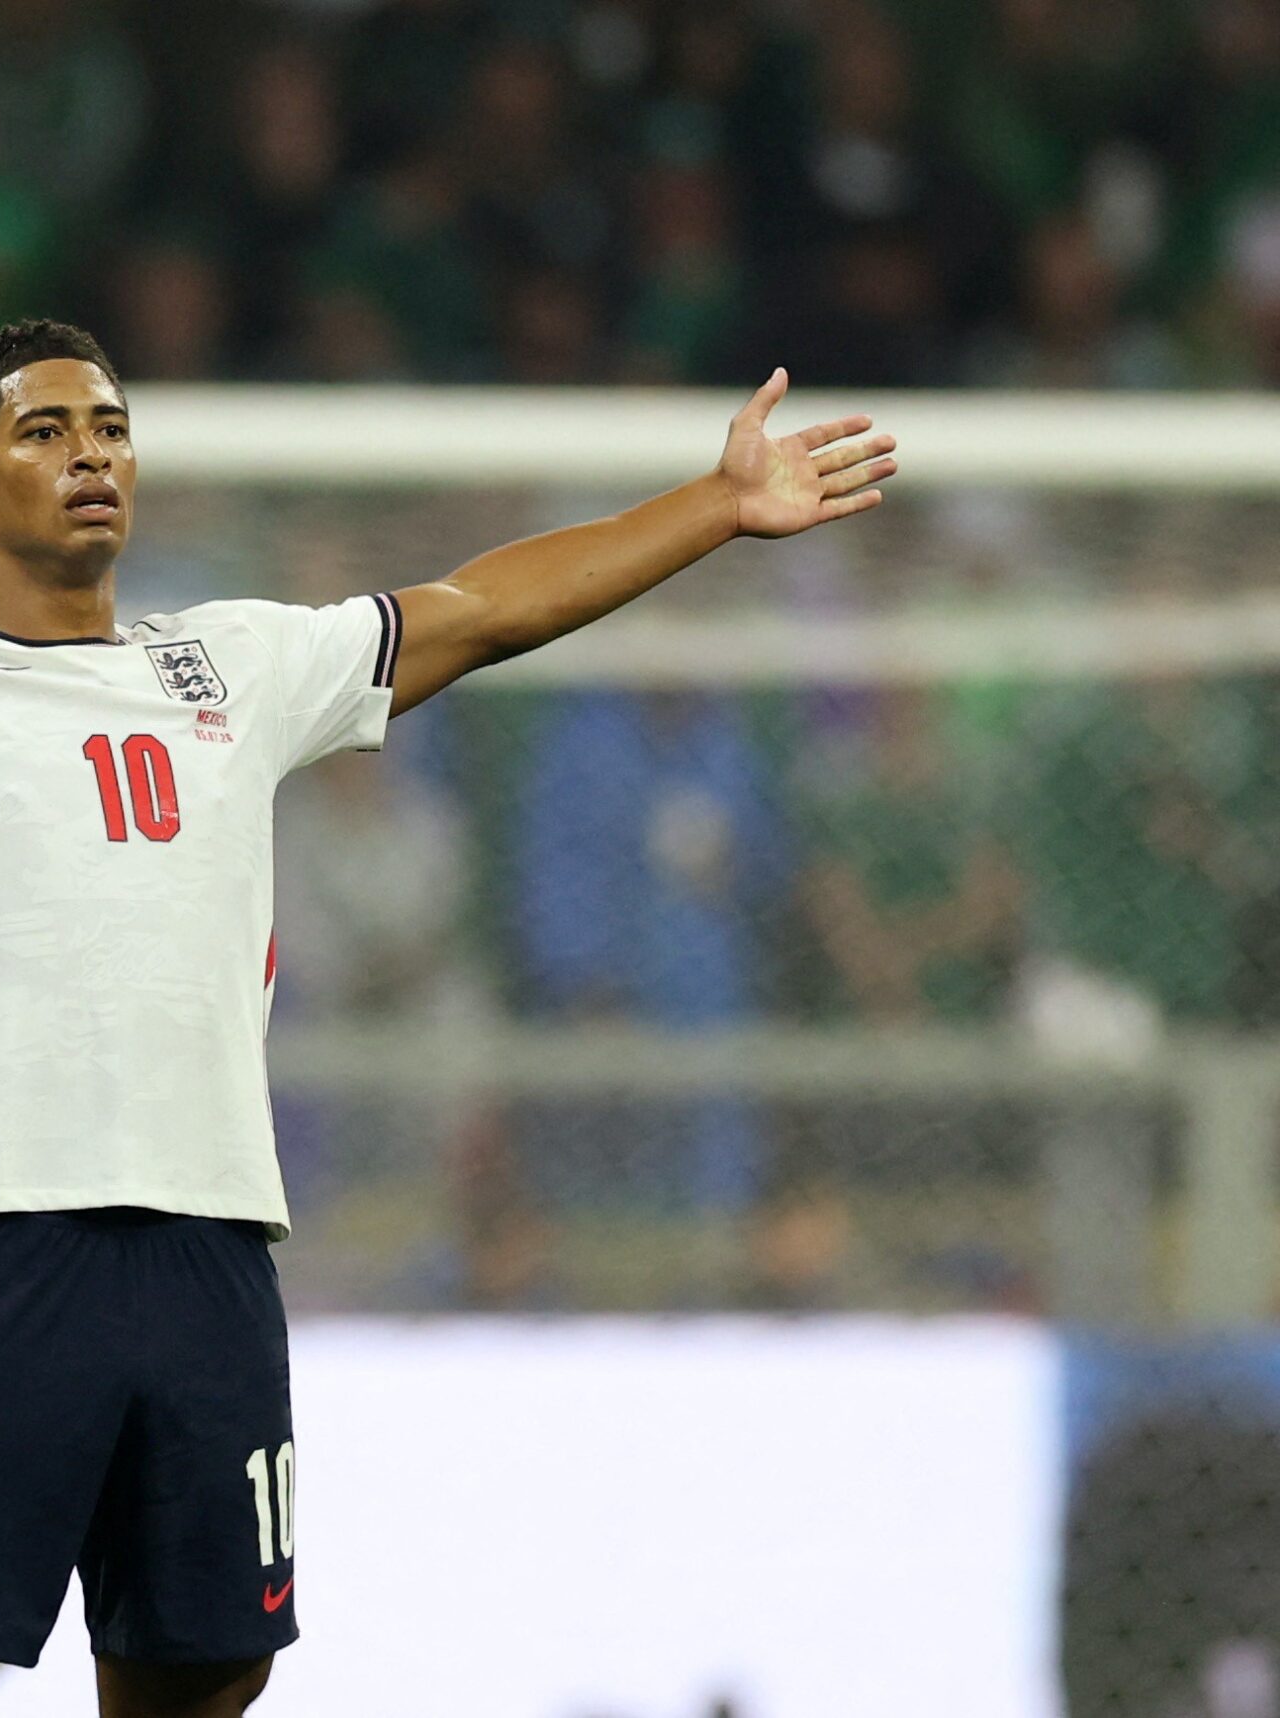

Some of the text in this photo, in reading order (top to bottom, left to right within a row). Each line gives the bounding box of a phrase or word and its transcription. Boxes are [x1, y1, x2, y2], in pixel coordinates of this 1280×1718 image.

[196, 709, 227, 727] MEXICO
[82, 734, 180, 842] 10
[246, 1441, 294, 1567] 10
